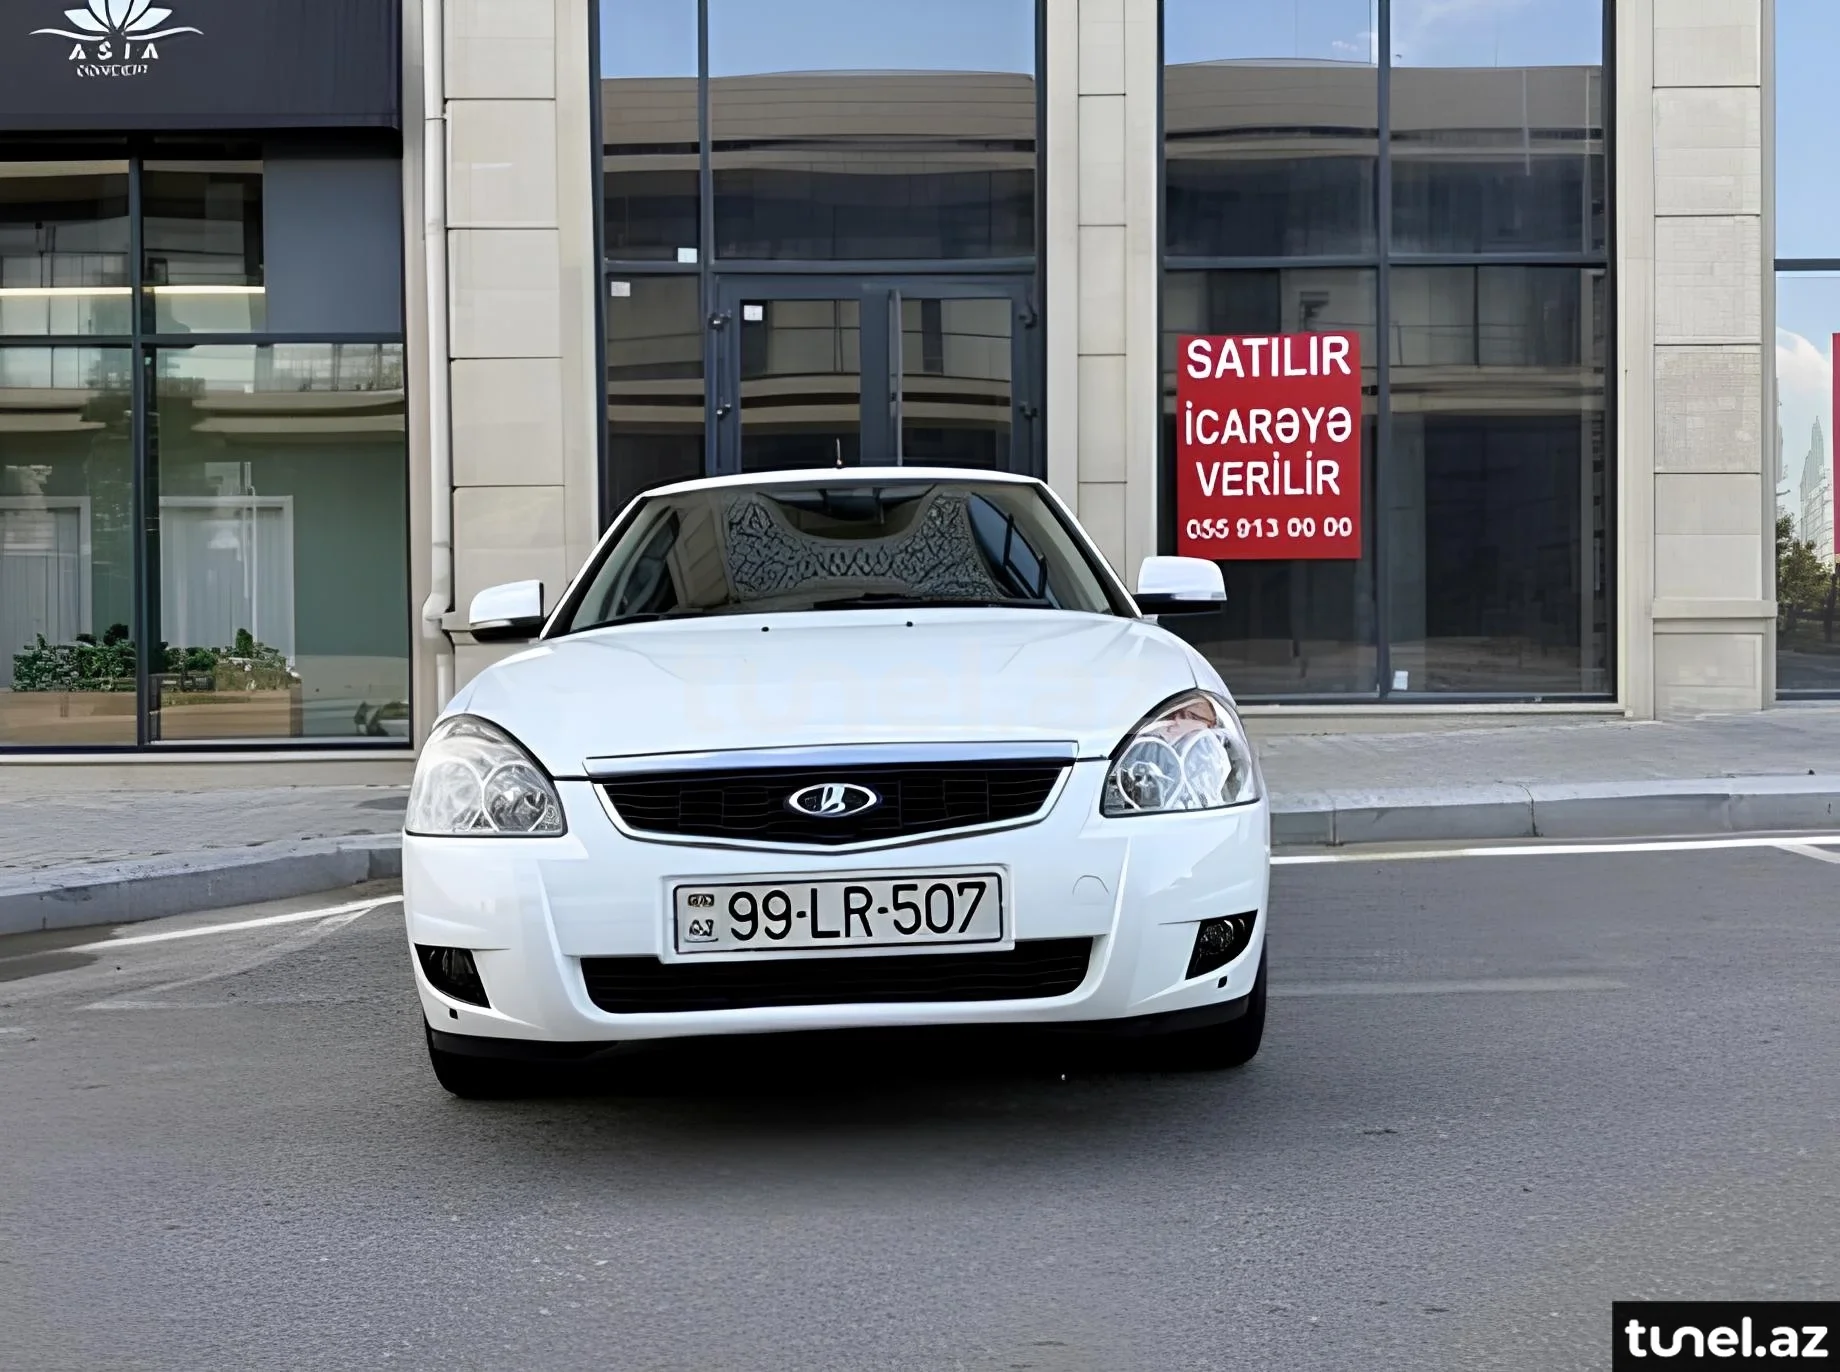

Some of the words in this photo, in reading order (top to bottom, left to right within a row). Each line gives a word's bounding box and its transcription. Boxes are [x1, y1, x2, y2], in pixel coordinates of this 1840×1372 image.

[69, 41, 159, 60] ASIA
[1186, 336, 1351, 379] SATILIR
[1185, 400, 1352, 445] İCARƏYƏ
[1195, 450, 1340, 497] VERİLİR
[1287, 516, 1316, 538] 00
[1323, 516, 1353, 538] 00
[728, 881, 987, 941] 99-LR-507
